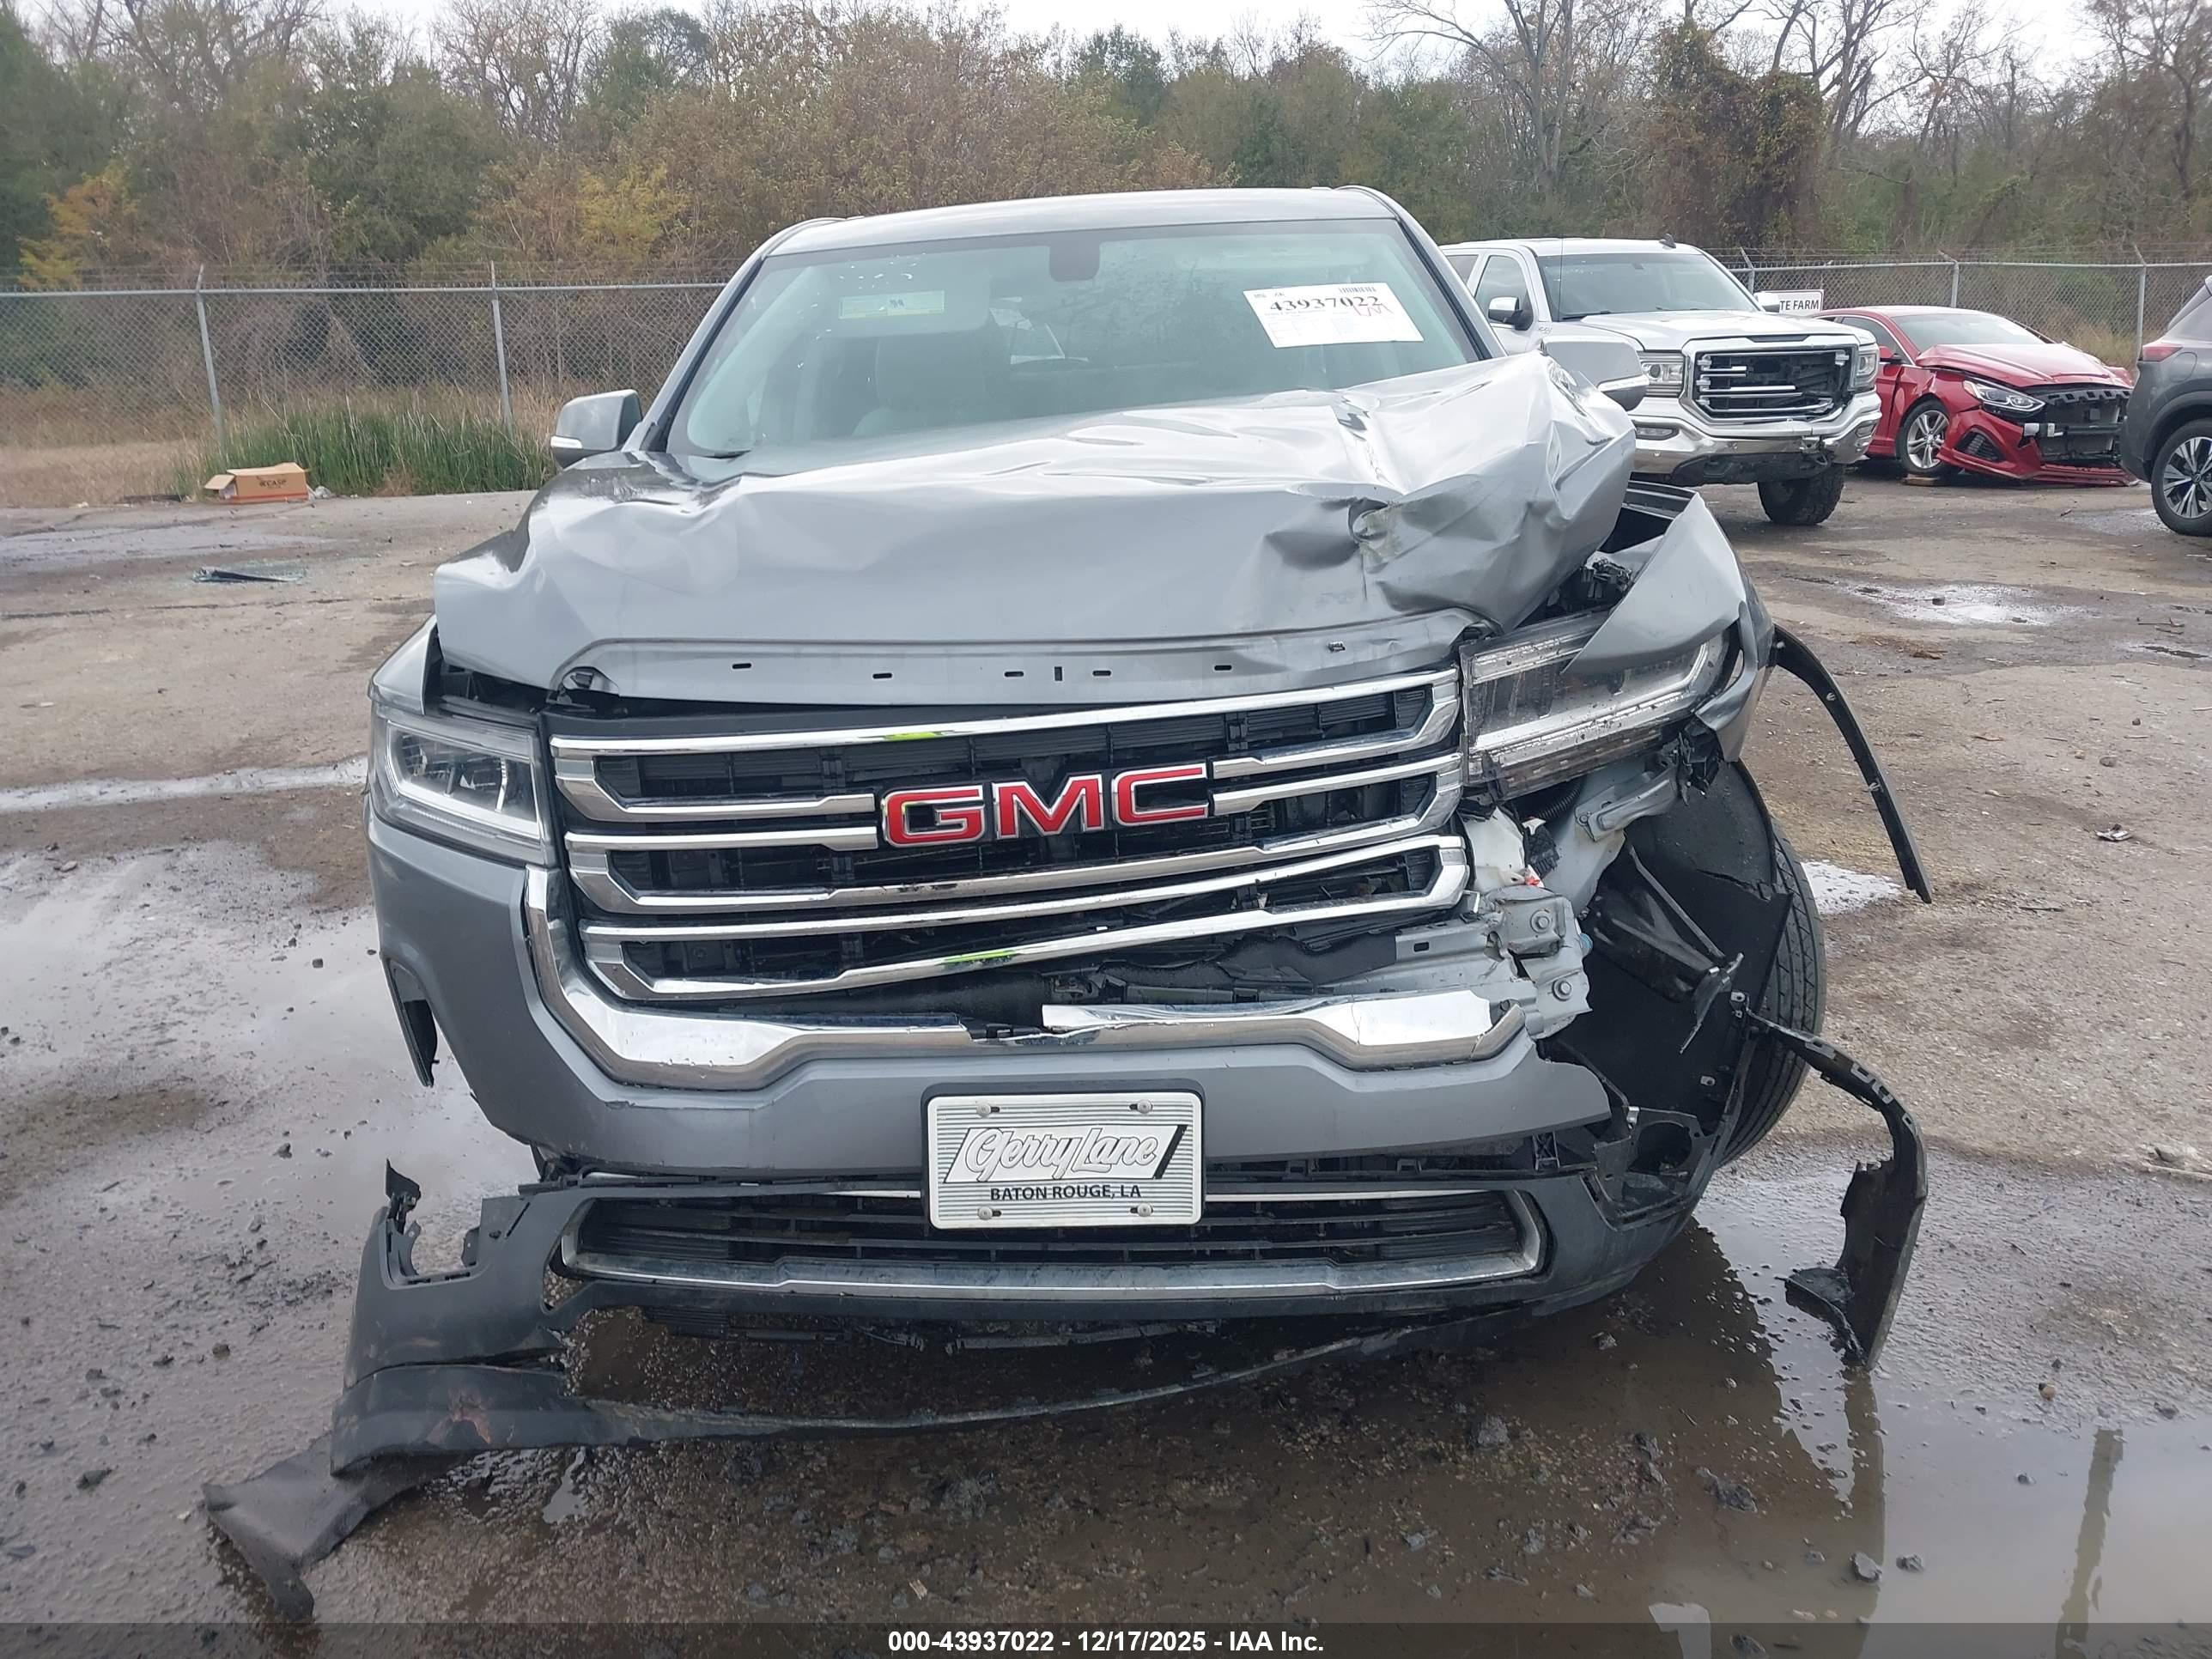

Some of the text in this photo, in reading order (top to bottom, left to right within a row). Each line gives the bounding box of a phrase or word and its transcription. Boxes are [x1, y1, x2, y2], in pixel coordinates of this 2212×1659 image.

[1270, 295, 1381, 311] 43937022
[1793, 300, 1819, 309] FARM
[881, 763, 1210, 848] GMC
[964, 1127, 1158, 1182] Gerry Lane
[989, 1184, 1142, 1201] BATON ROUGE, LA
